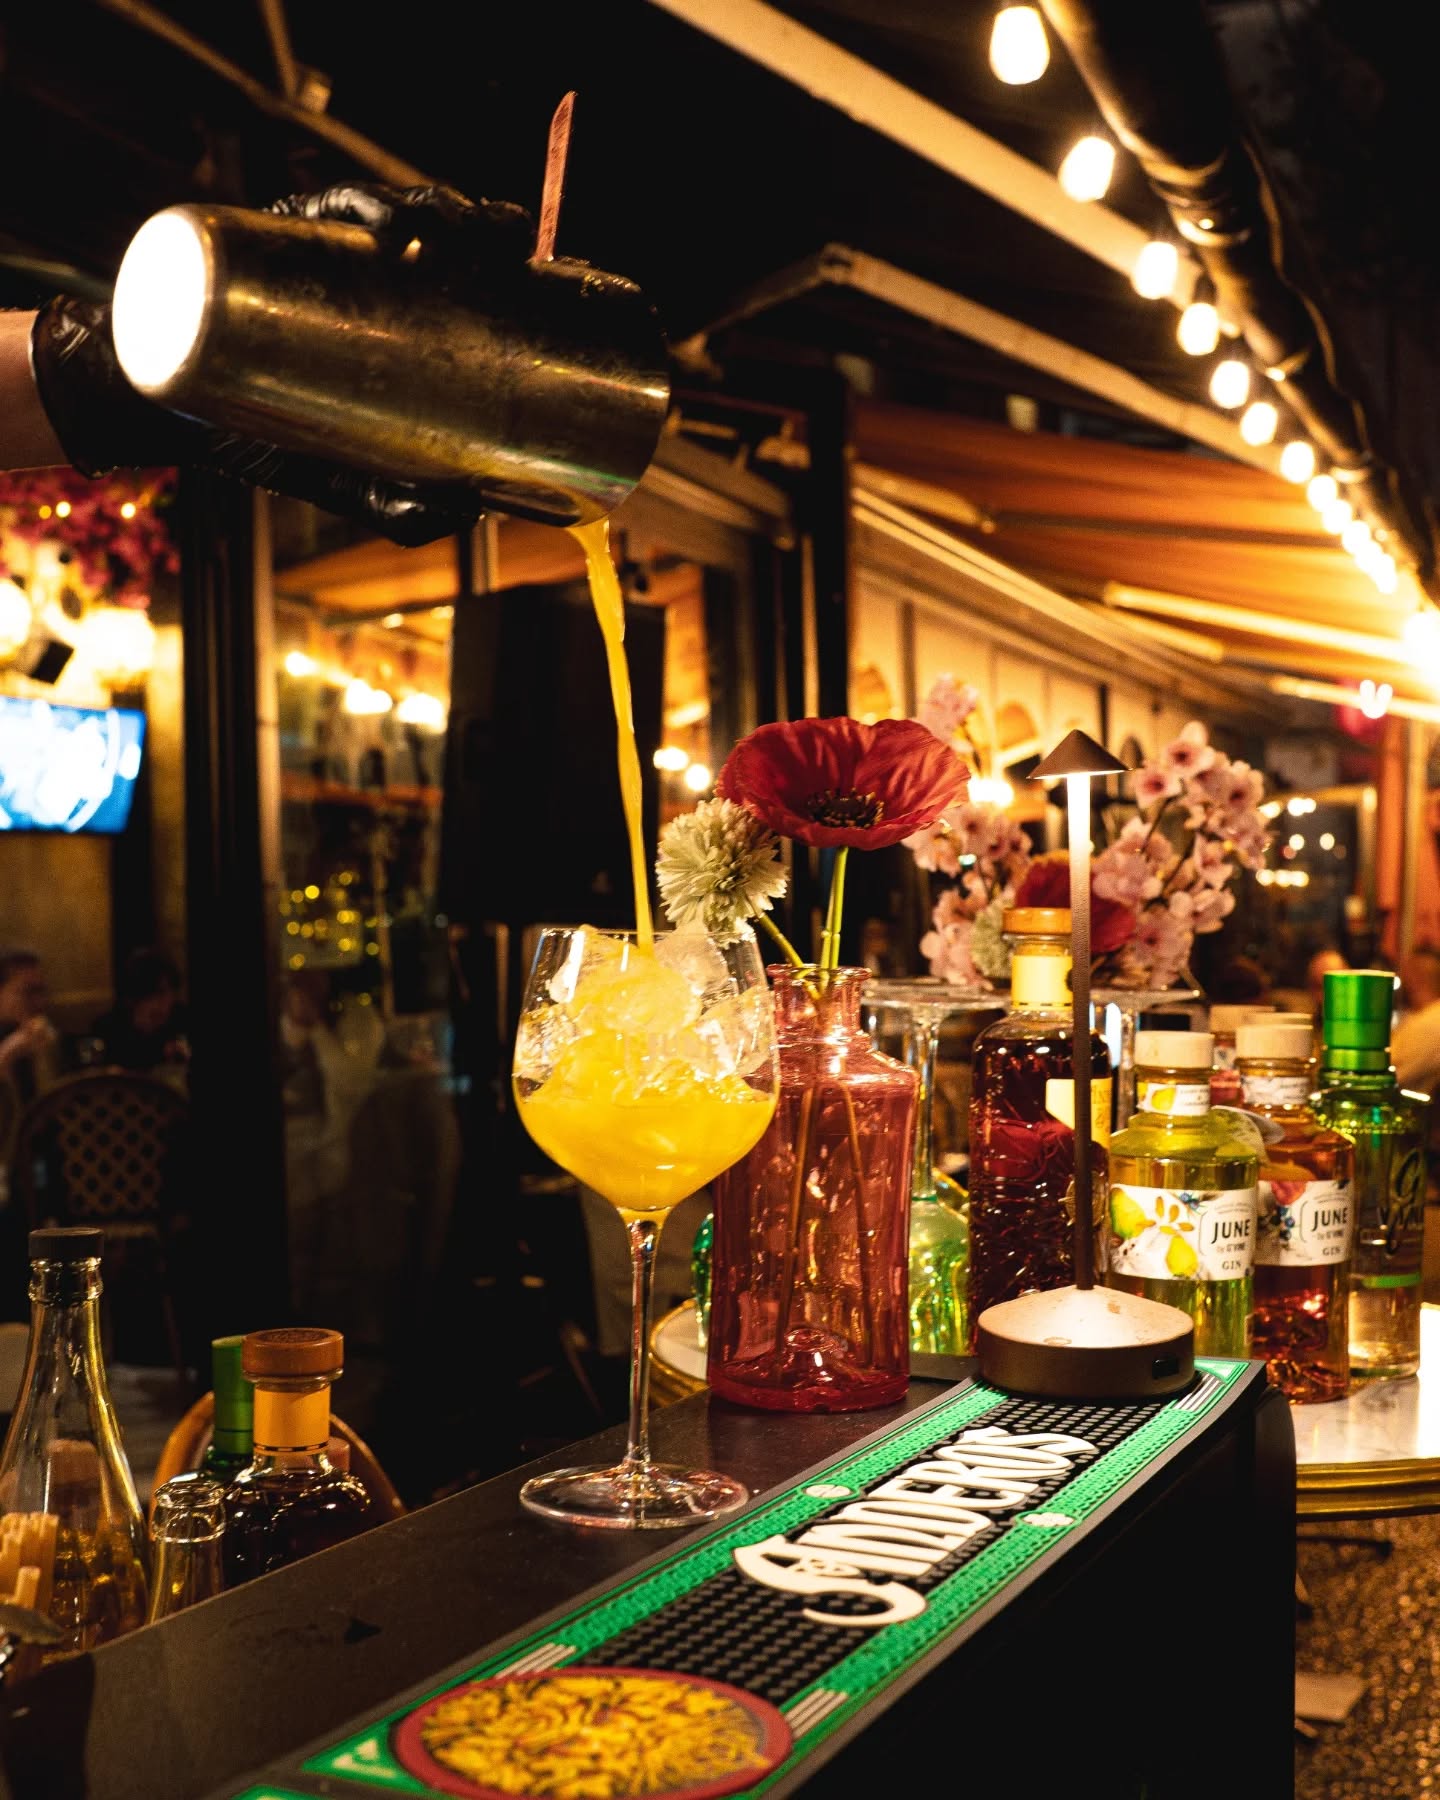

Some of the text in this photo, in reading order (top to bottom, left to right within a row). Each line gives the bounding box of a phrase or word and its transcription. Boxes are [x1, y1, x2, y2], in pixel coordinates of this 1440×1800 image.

[1211, 1219, 1250, 1244] JUNE
[1311, 1207, 1348, 1232] JUNE
[1221, 1260, 1242, 1270] GIN
